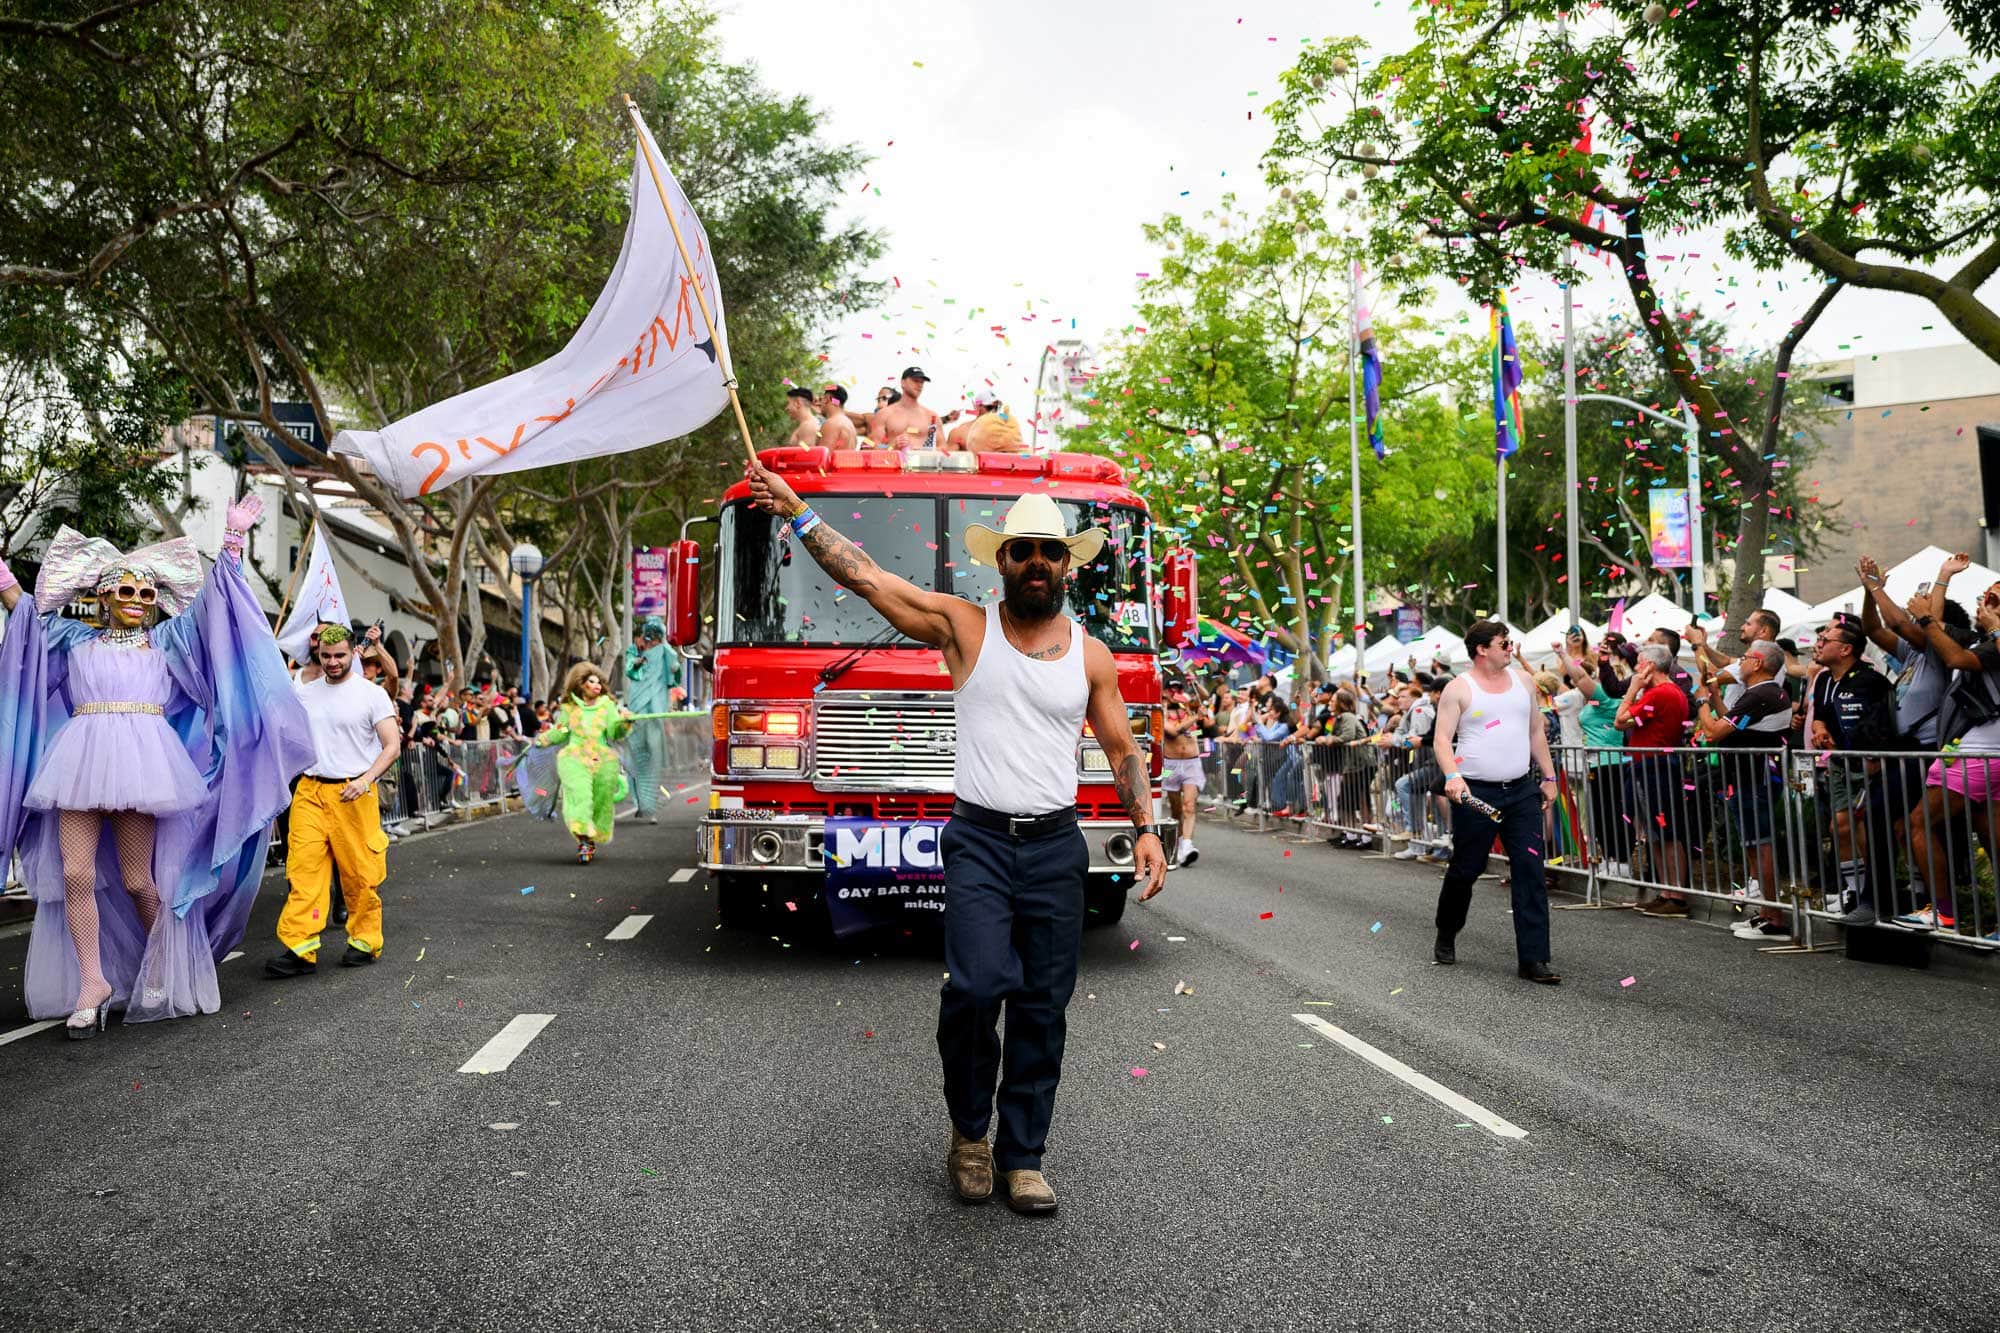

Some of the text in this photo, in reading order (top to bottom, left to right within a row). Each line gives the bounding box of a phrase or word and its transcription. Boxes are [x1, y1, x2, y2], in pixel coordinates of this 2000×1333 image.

[836, 825, 944, 868] MIC
[838, 884, 946, 899] GAY BAR AN
